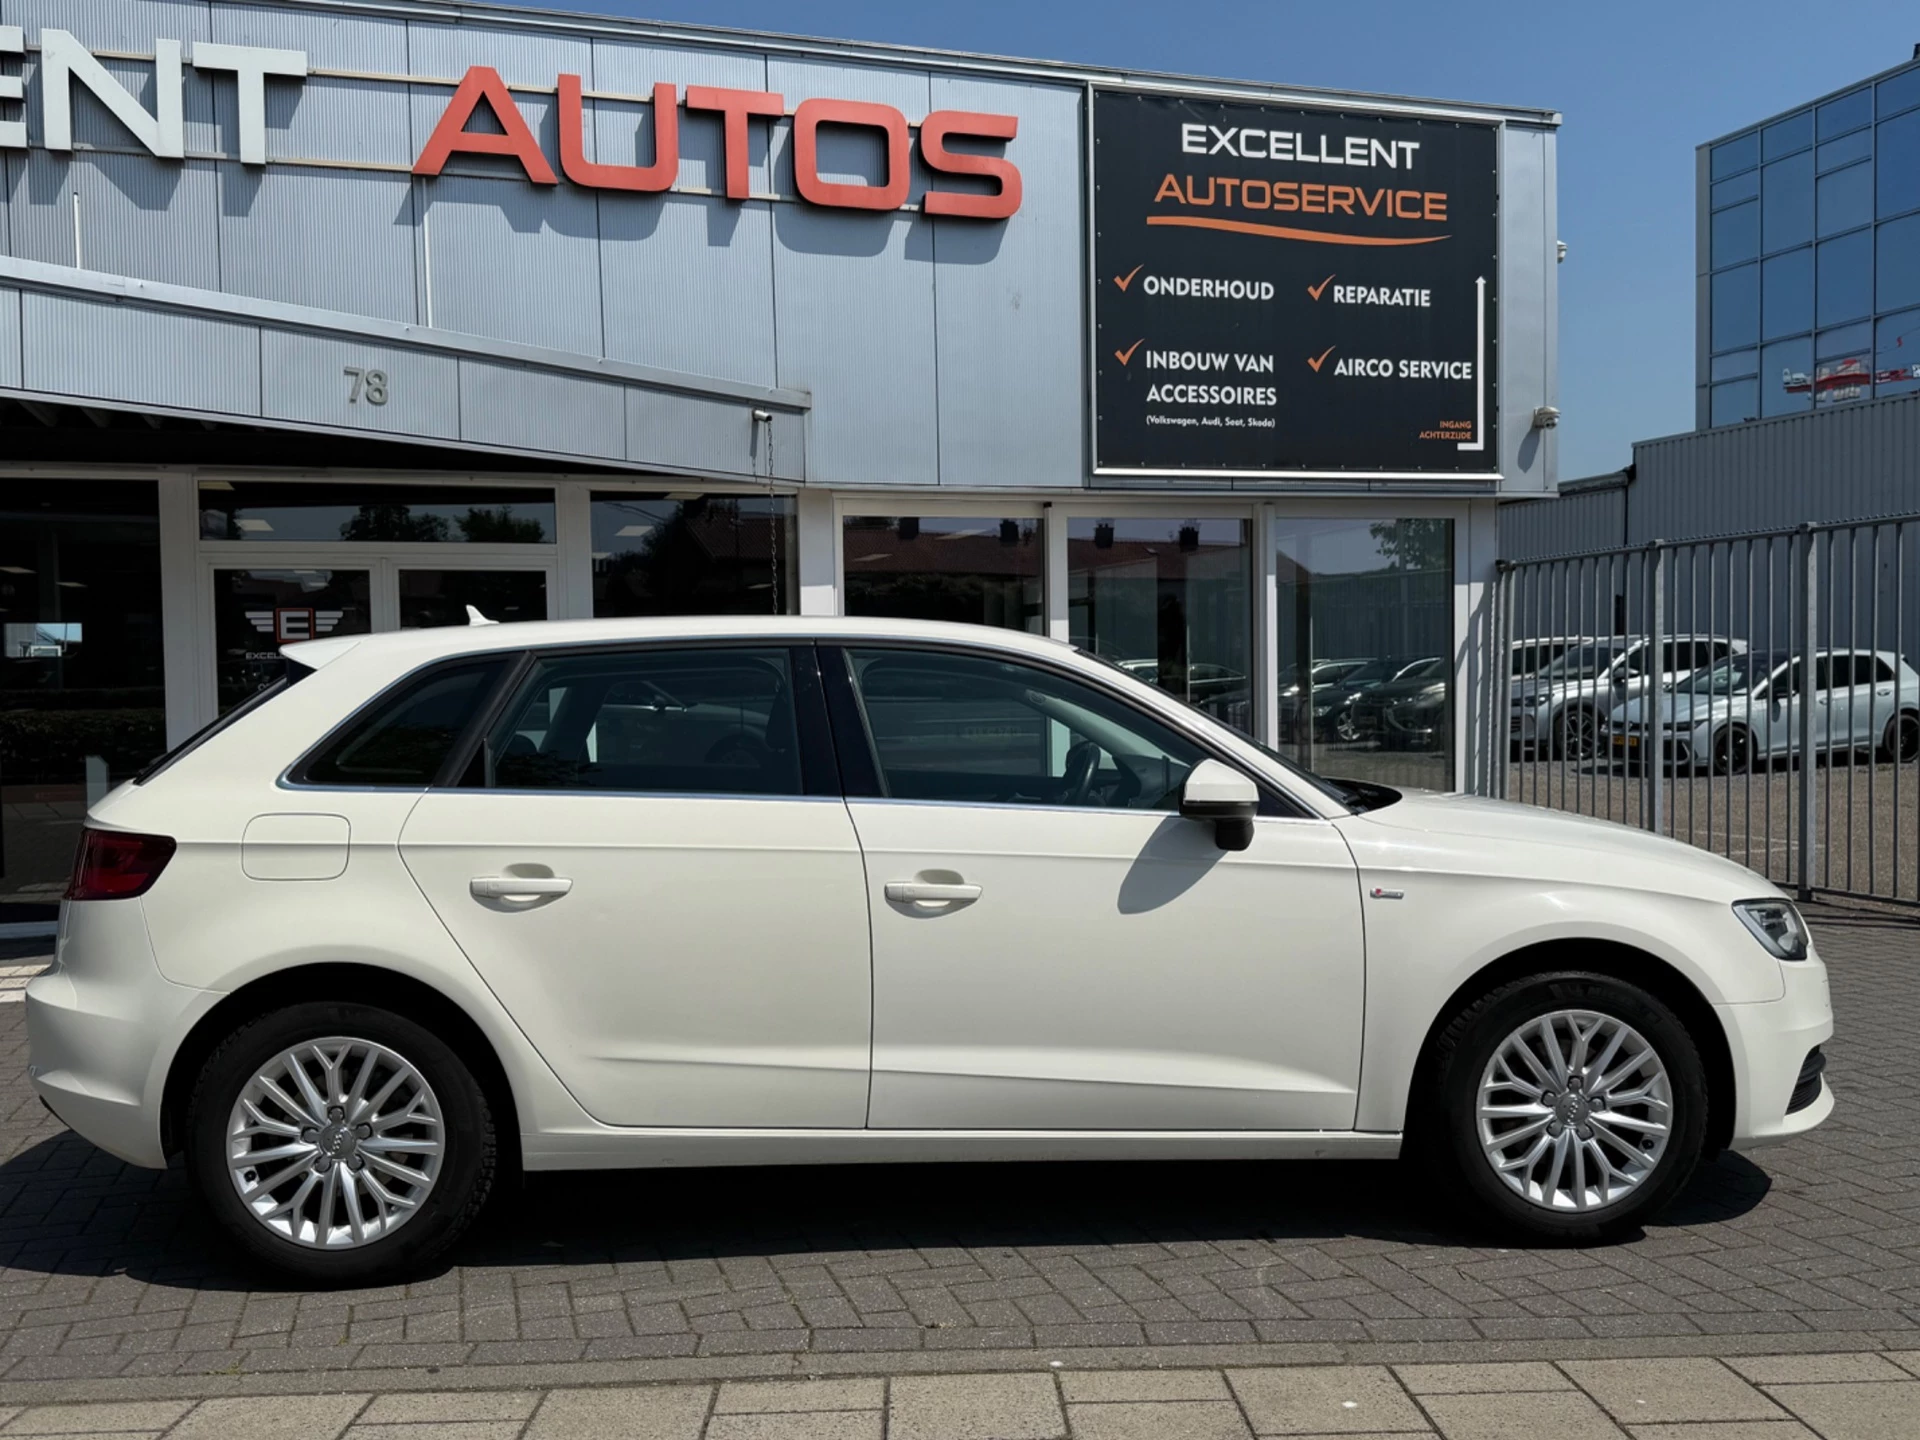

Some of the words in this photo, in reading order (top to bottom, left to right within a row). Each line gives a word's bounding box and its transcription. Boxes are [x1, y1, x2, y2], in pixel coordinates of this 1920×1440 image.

[0, 25, 306, 165] NT
[412, 66, 1022, 218] AUTOS
[1181, 122, 1420, 170] EXCELLENT
[1153, 173, 1448, 222] AUTOSERVICE
[1143, 276, 1275, 301] ONDERHOUD
[1333, 284, 1431, 308] REPARATIE
[1146, 350, 1229, 372] INBOUW
[1233, 353, 1274, 374] VAN
[1333, 357, 1394, 378] AIRCO
[1398, 359, 1473, 380] SERVICE
[344, 366, 388, 406] 78
[1146, 384, 1277, 406] ACCESSOIRES
[1146, 415, 1199, 427] (Volkswagen,
[1201, 417, 1223, 427] Audi,
[1225, 417, 1246, 427] Seat,
[1247, 417, 1276, 429] Skoda)
[1439, 420, 1472, 429] INGANG
[280, 611, 310, 640] E
